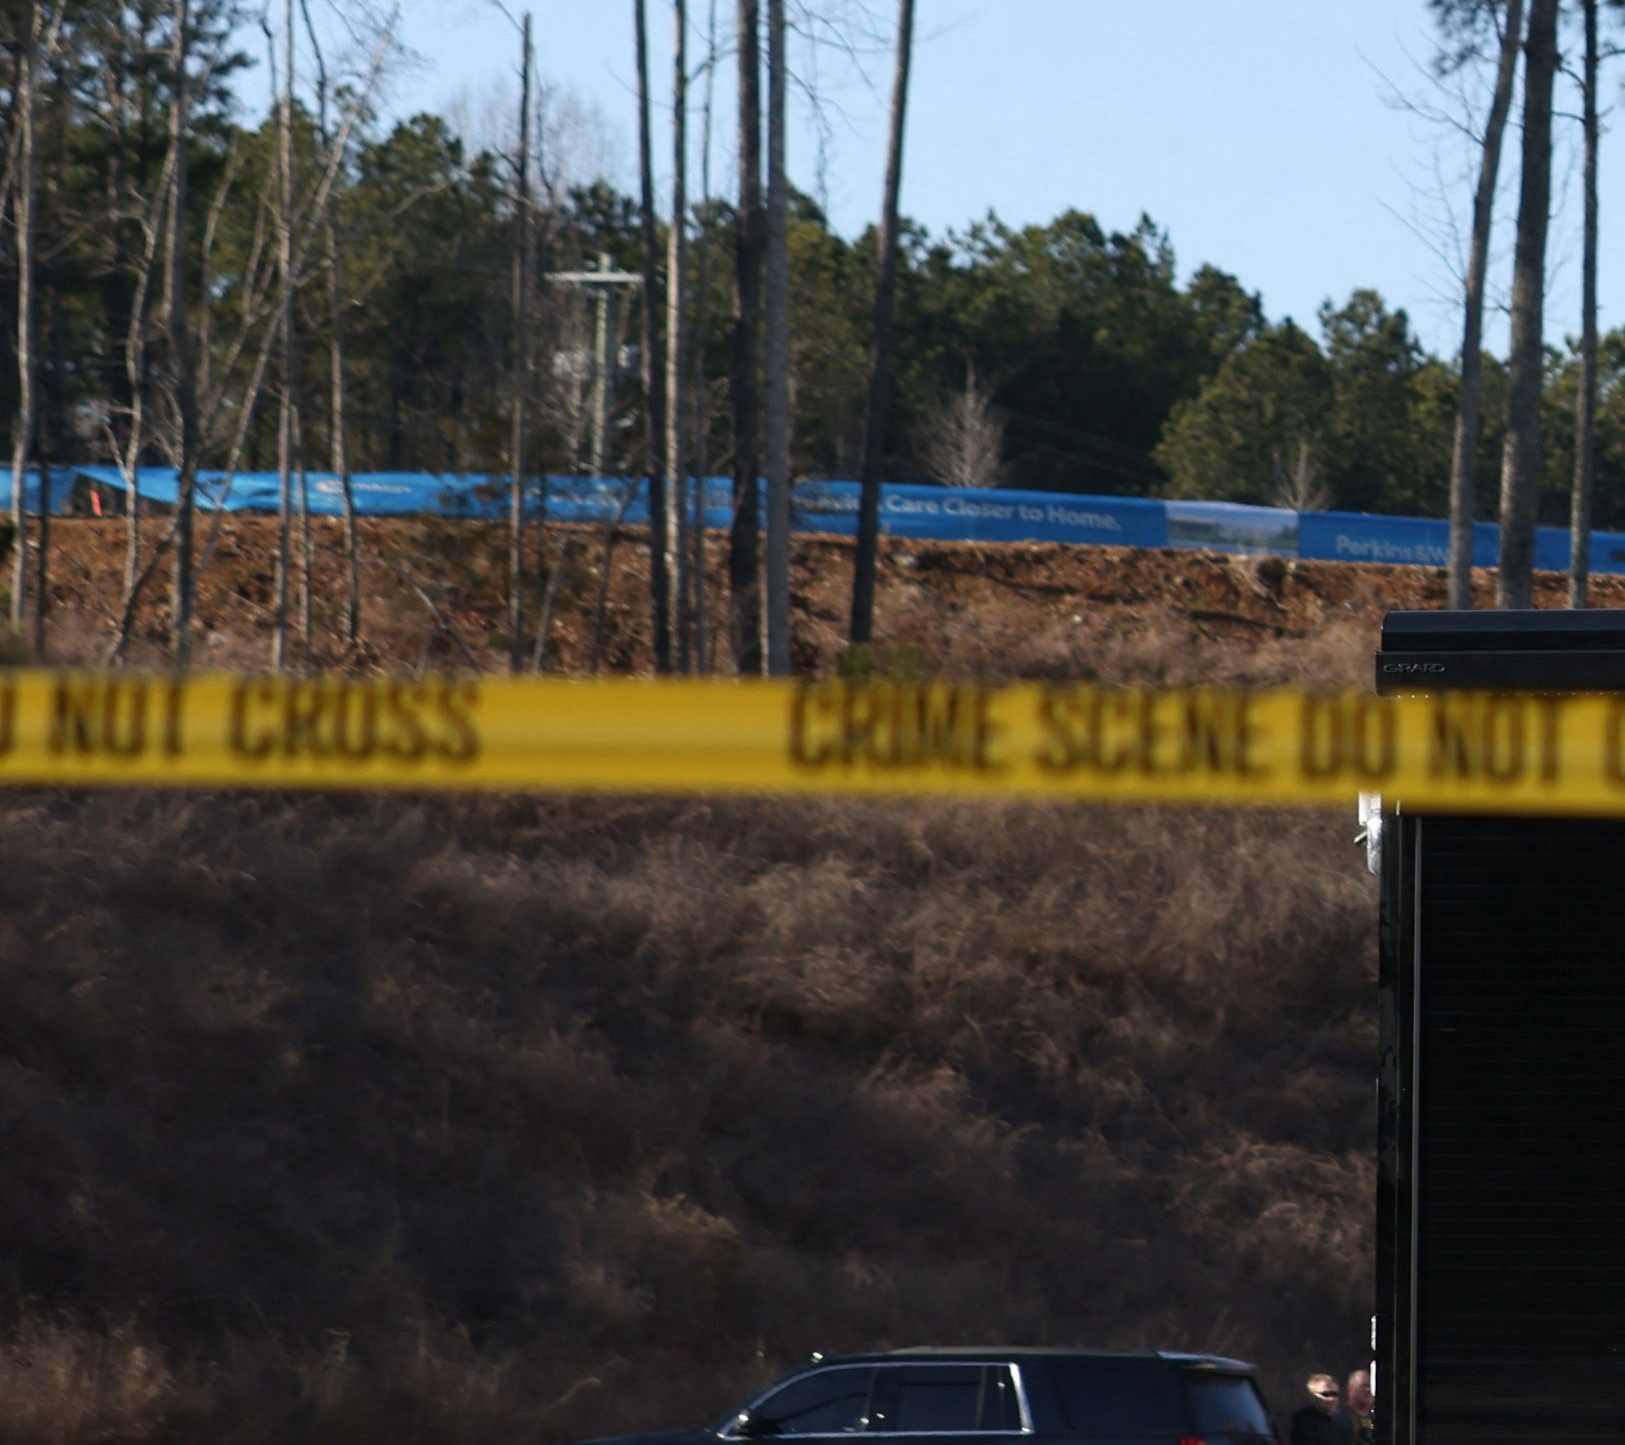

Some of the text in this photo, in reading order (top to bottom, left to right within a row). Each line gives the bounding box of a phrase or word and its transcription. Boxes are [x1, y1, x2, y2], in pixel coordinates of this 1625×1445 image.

[886, 493, 939, 515] Care
[1019, 505, 1043, 522] to
[48, 676, 188, 760] NOT
[228, 677, 480, 769] CROSS
[789, 683, 1004, 774] CRIME
[1035, 688, 1274, 780] SCENE
[1299, 691, 1397, 784] DO
[1428, 697, 1564, 789] NOT
